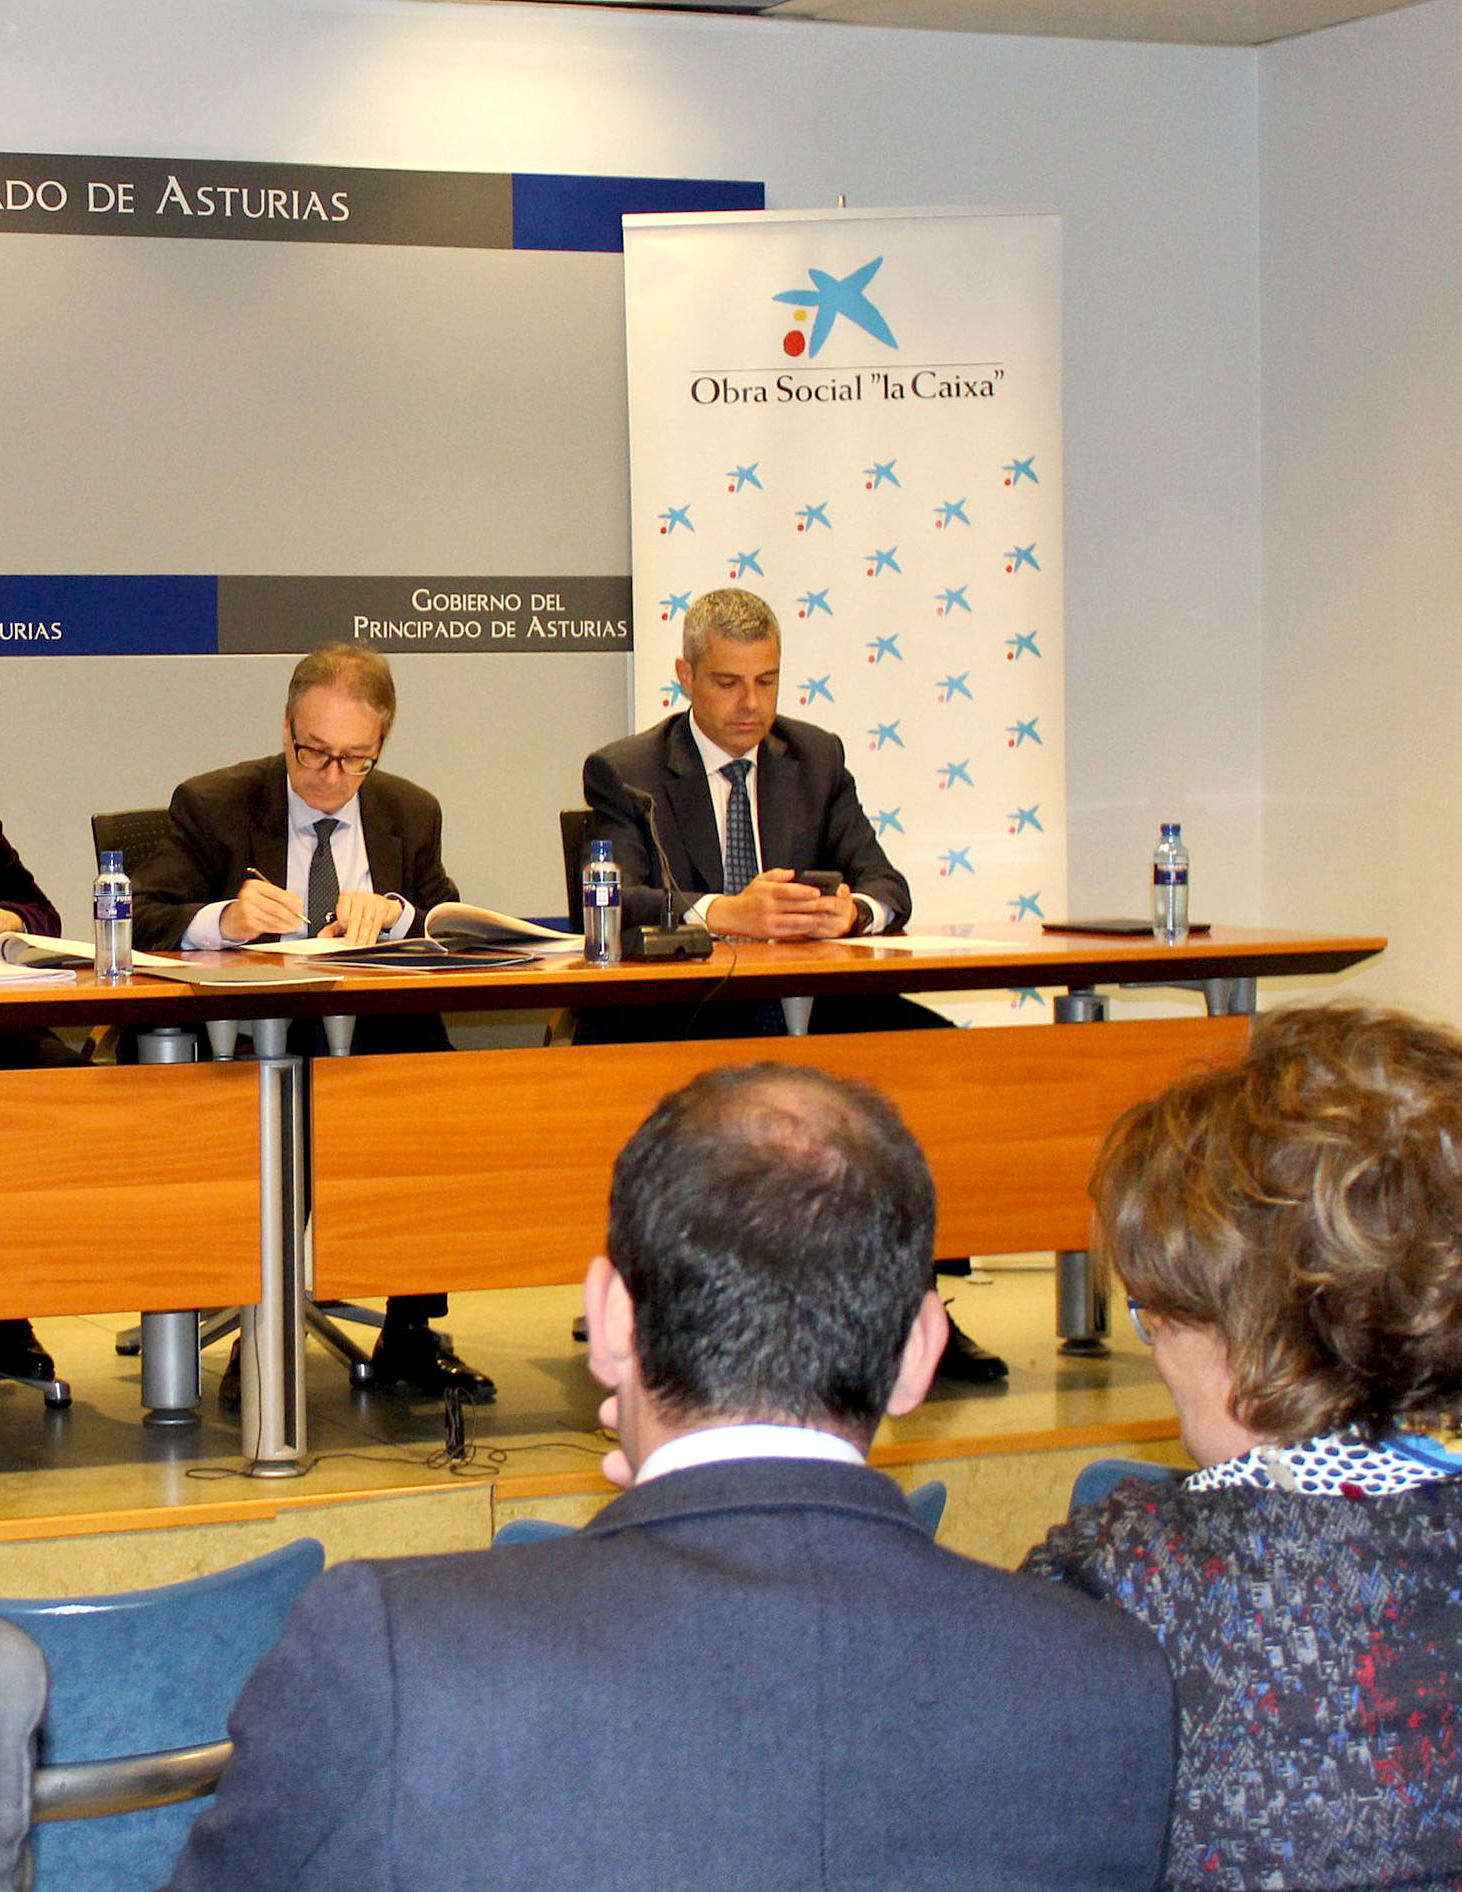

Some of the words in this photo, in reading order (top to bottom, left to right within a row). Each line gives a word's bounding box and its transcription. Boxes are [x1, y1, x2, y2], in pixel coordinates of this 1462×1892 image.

[87, 182, 135, 214] DE
[155, 174, 352, 222] ASTURIAS
[690, 376, 768, 405] Obra
[775, 374, 862, 403] Social
[411, 588, 522, 612] GOBIERNO
[531, 594, 566, 612] DEL
[354, 615, 482, 639] PRINCIPADO
[491, 620, 516, 638] DE
[526, 615, 628, 638] ASTURIAS
